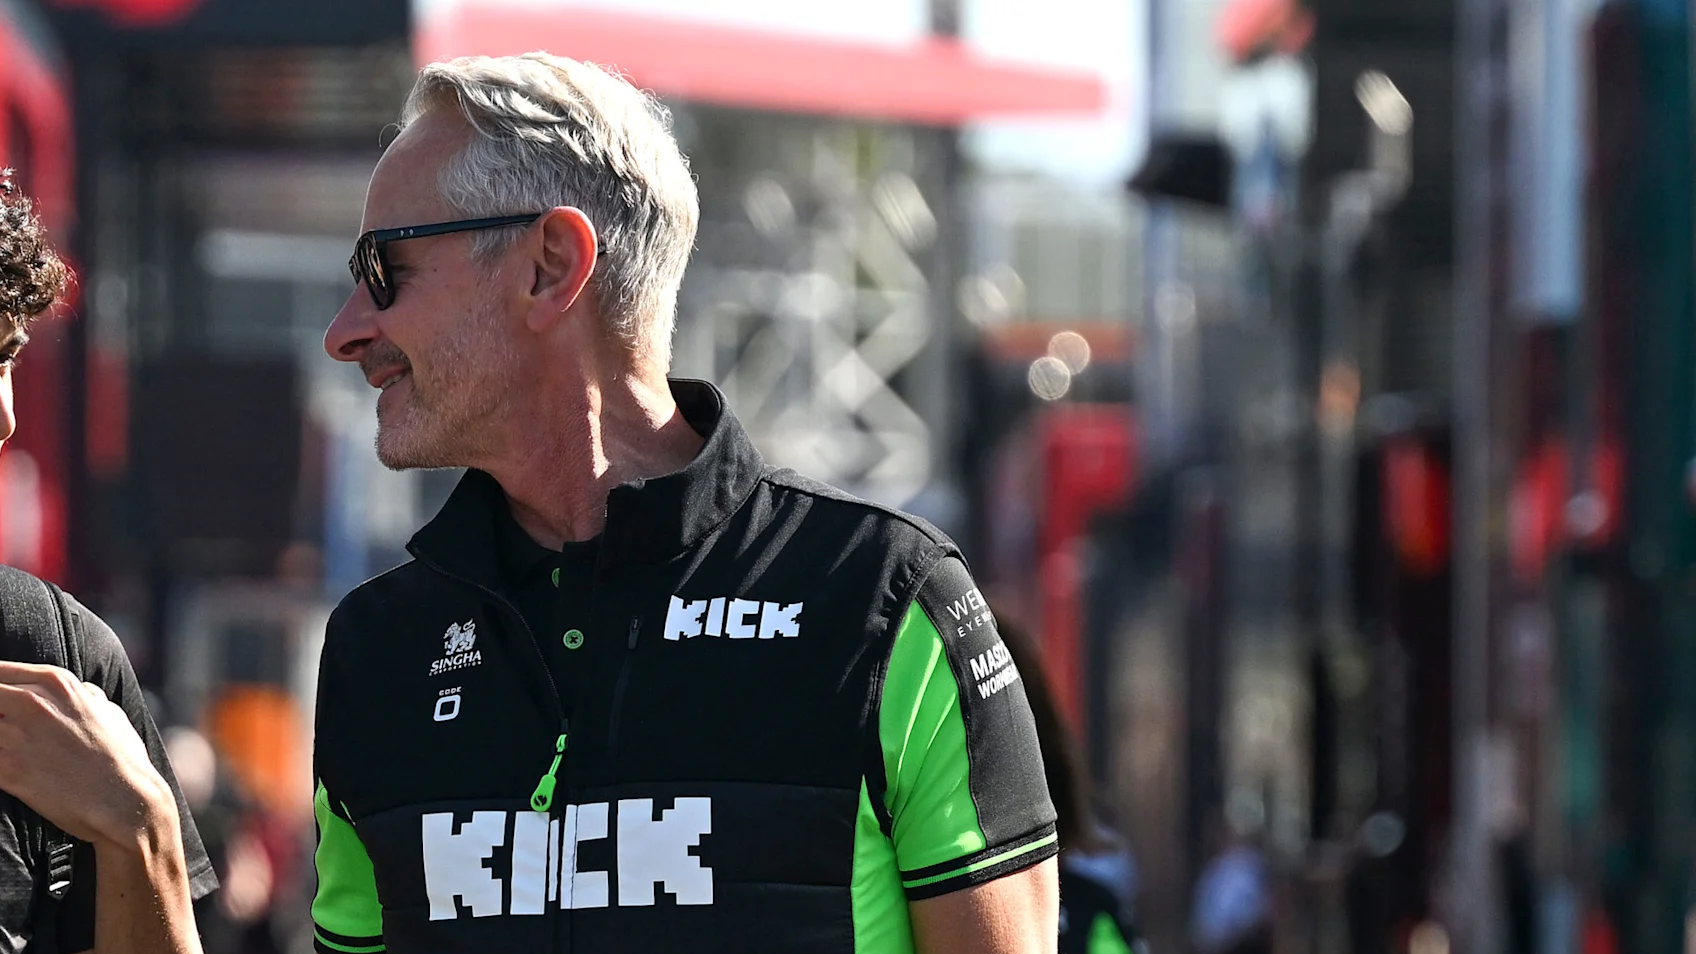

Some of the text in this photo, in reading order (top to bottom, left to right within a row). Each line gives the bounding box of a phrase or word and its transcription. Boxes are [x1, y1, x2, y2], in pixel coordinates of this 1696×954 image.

[664, 594, 804, 641] KICK
[430, 650, 482, 672] SINGHA
[438, 686, 462, 696] CODE
[422, 797, 713, 921] KICK
